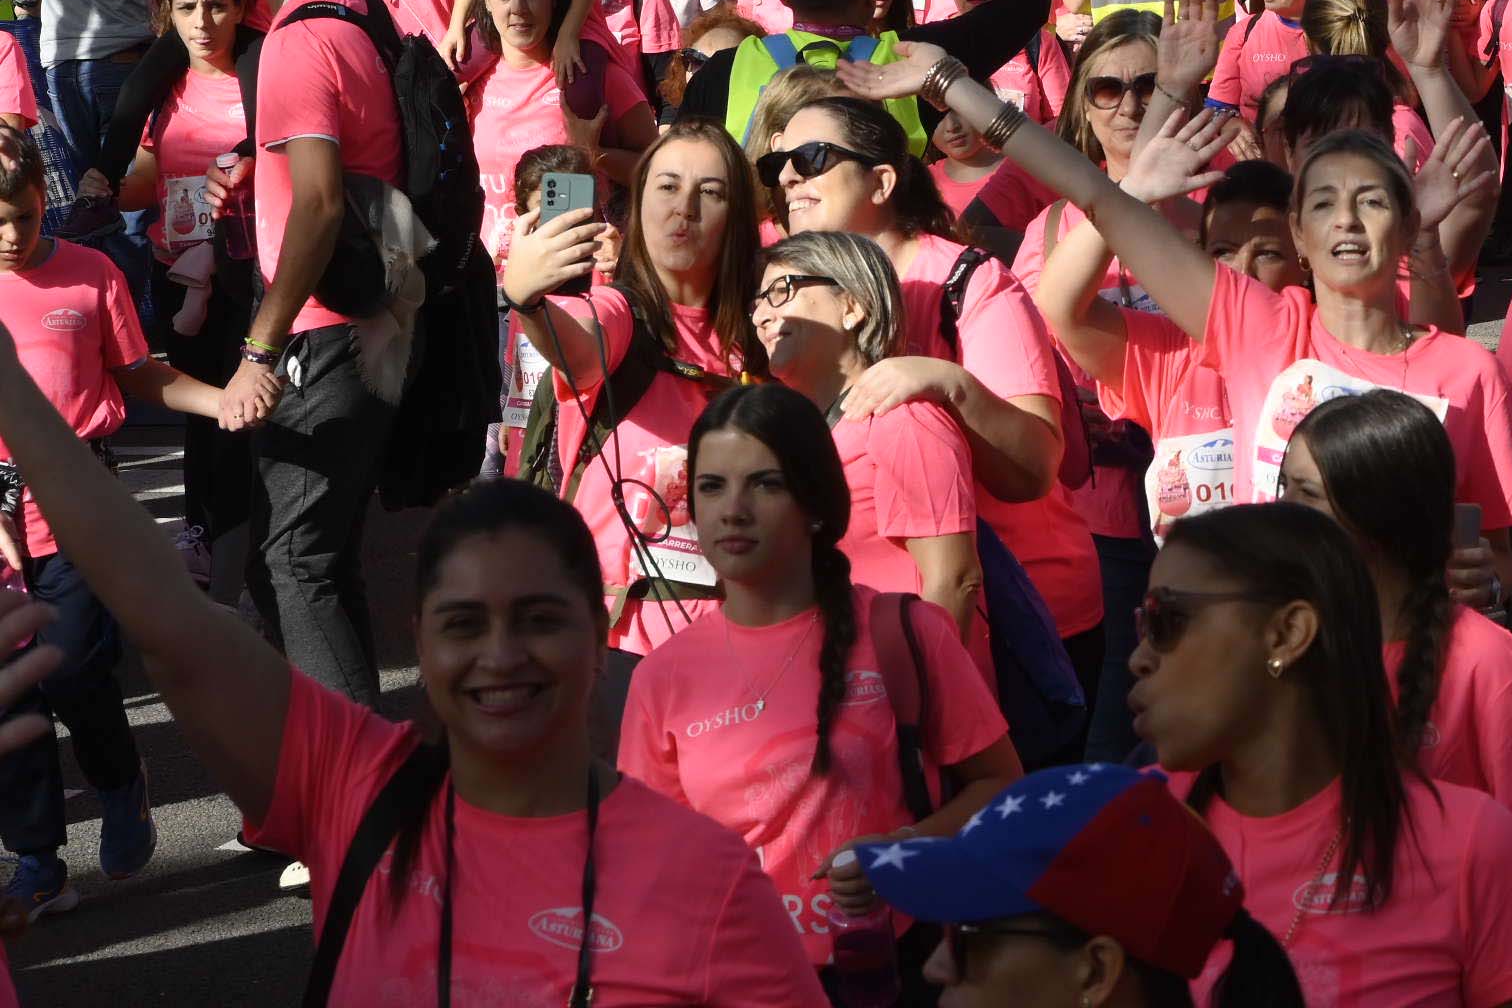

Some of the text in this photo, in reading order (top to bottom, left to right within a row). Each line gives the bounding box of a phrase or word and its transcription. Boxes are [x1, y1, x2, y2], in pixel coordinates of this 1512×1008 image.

[656, 537, 698, 551] ARRERA
[686, 702, 763, 738] OYSHO
[538, 917, 615, 949] ASTURANA
